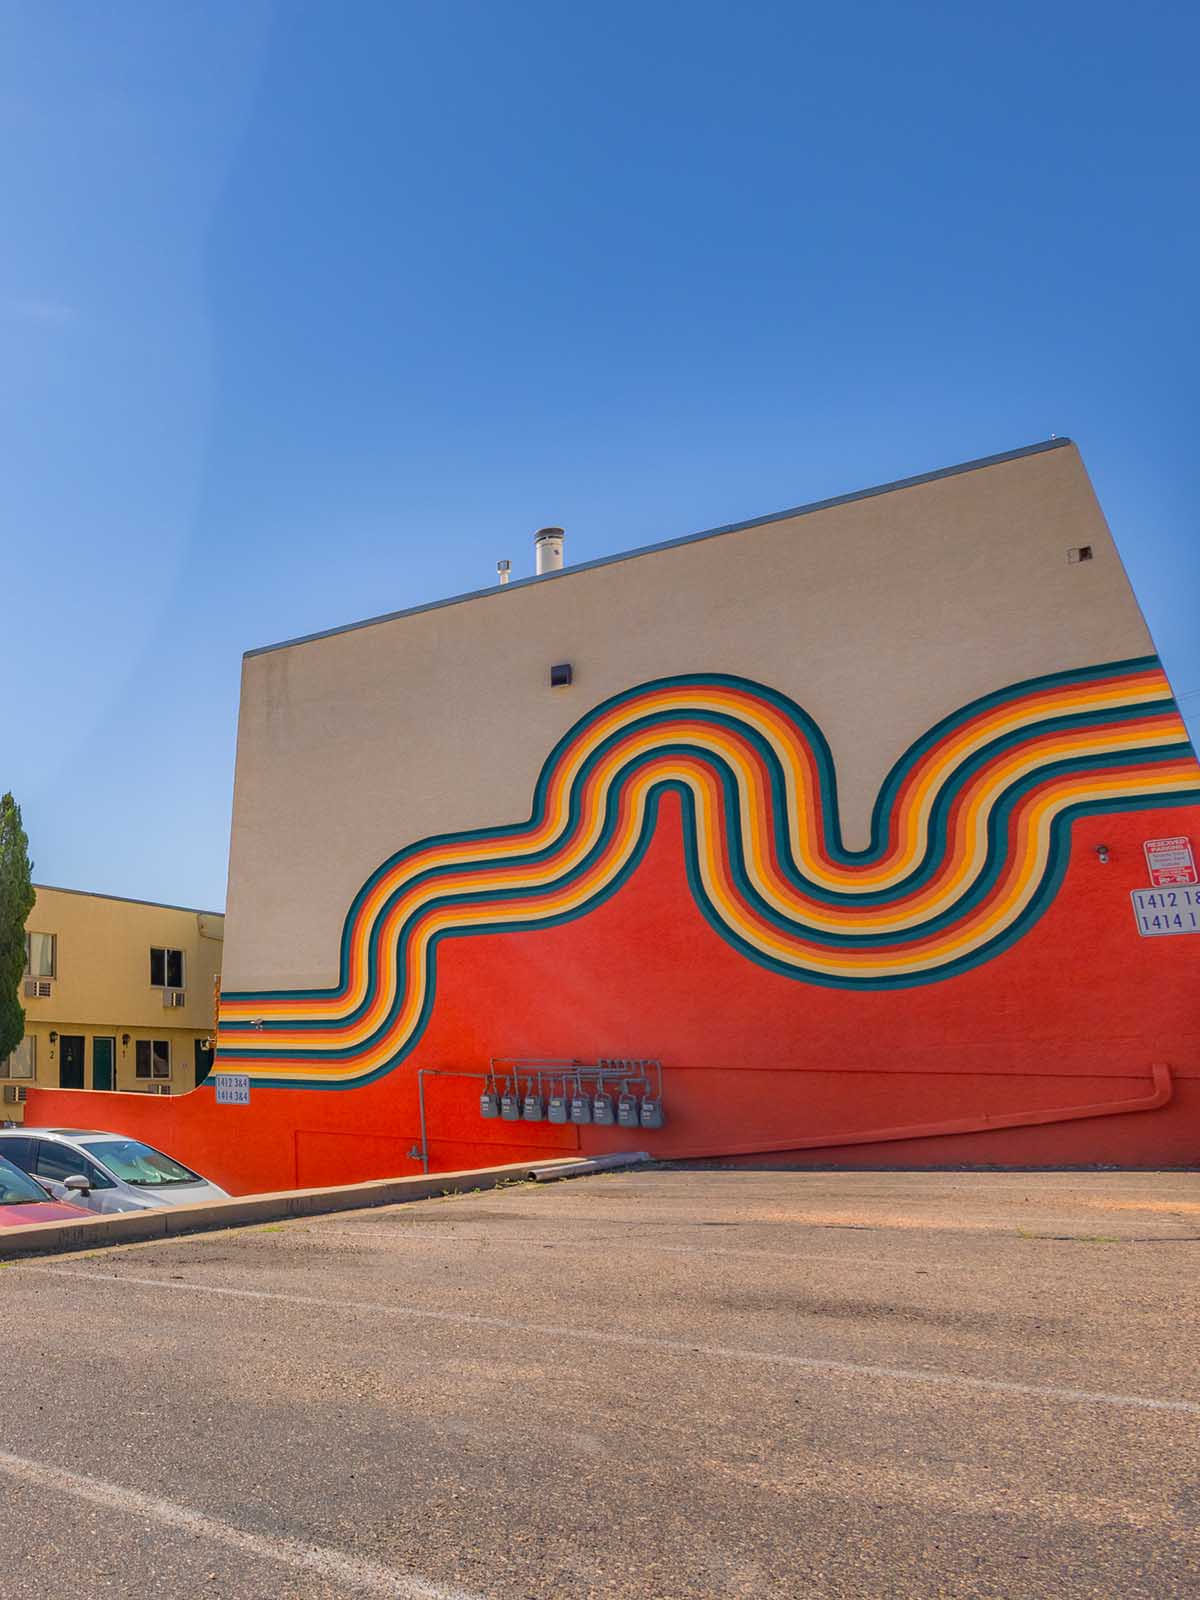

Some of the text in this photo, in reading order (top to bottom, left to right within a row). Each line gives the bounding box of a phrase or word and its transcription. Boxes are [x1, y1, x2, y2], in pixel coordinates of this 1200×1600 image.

[1138, 892, 1177, 909] 1412
[1142, 913, 1182, 930] 1414
[217, 1077, 247, 1087] 1412 3&4
[217, 1090, 248, 1101] 1414 3&4
